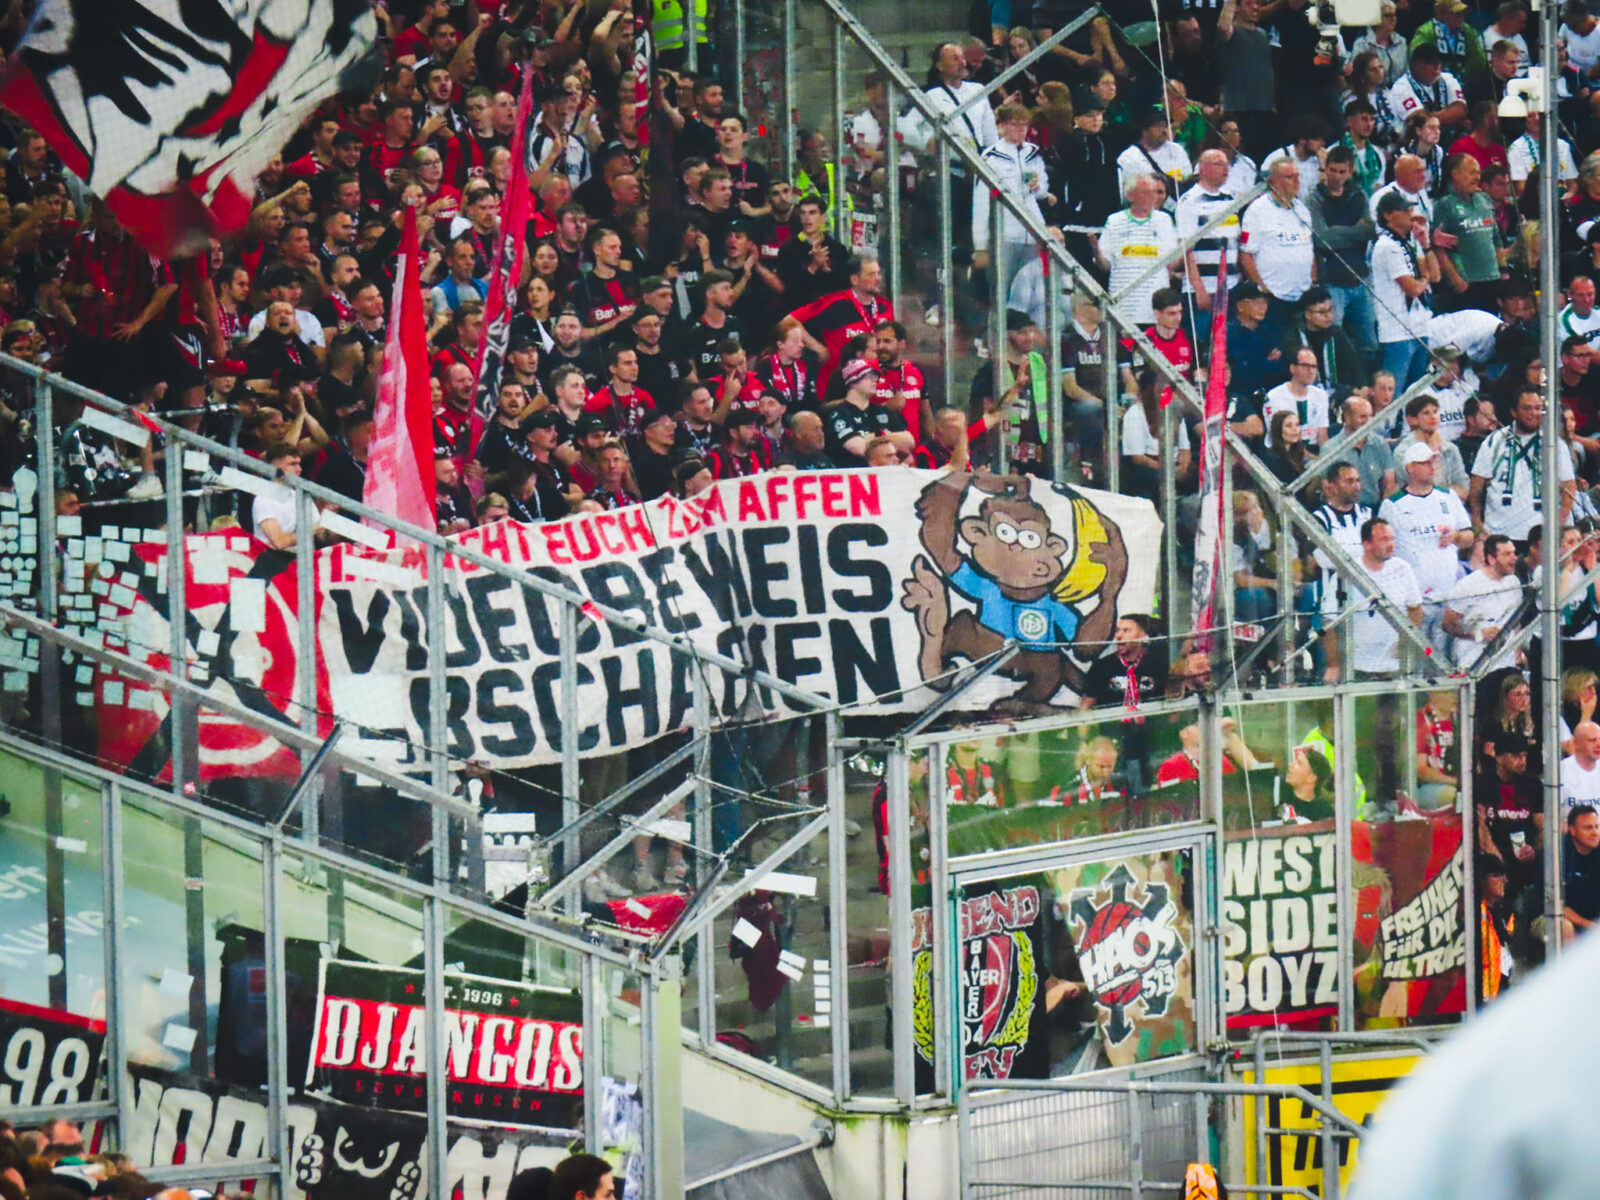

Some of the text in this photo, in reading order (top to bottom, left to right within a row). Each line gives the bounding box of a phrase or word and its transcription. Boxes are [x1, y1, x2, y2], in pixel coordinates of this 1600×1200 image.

[402, 519, 532, 579] MCHT
[541, 508, 657, 565] EUCH
[658, 484, 728, 539] ZUM
[738, 473, 882, 522] AFFEN
[1224, 832, 1337, 897] WEST
[1223, 892, 1338, 957] SIDE
[1384, 927, 1425, 961] FÜR
[462, 987, 503, 1007] 1996
[961, 968, 1000, 988] AYER
[1223, 950, 1339, 1014] BOYZ
[355, 1078, 543, 1112] LEVEKUSEN
